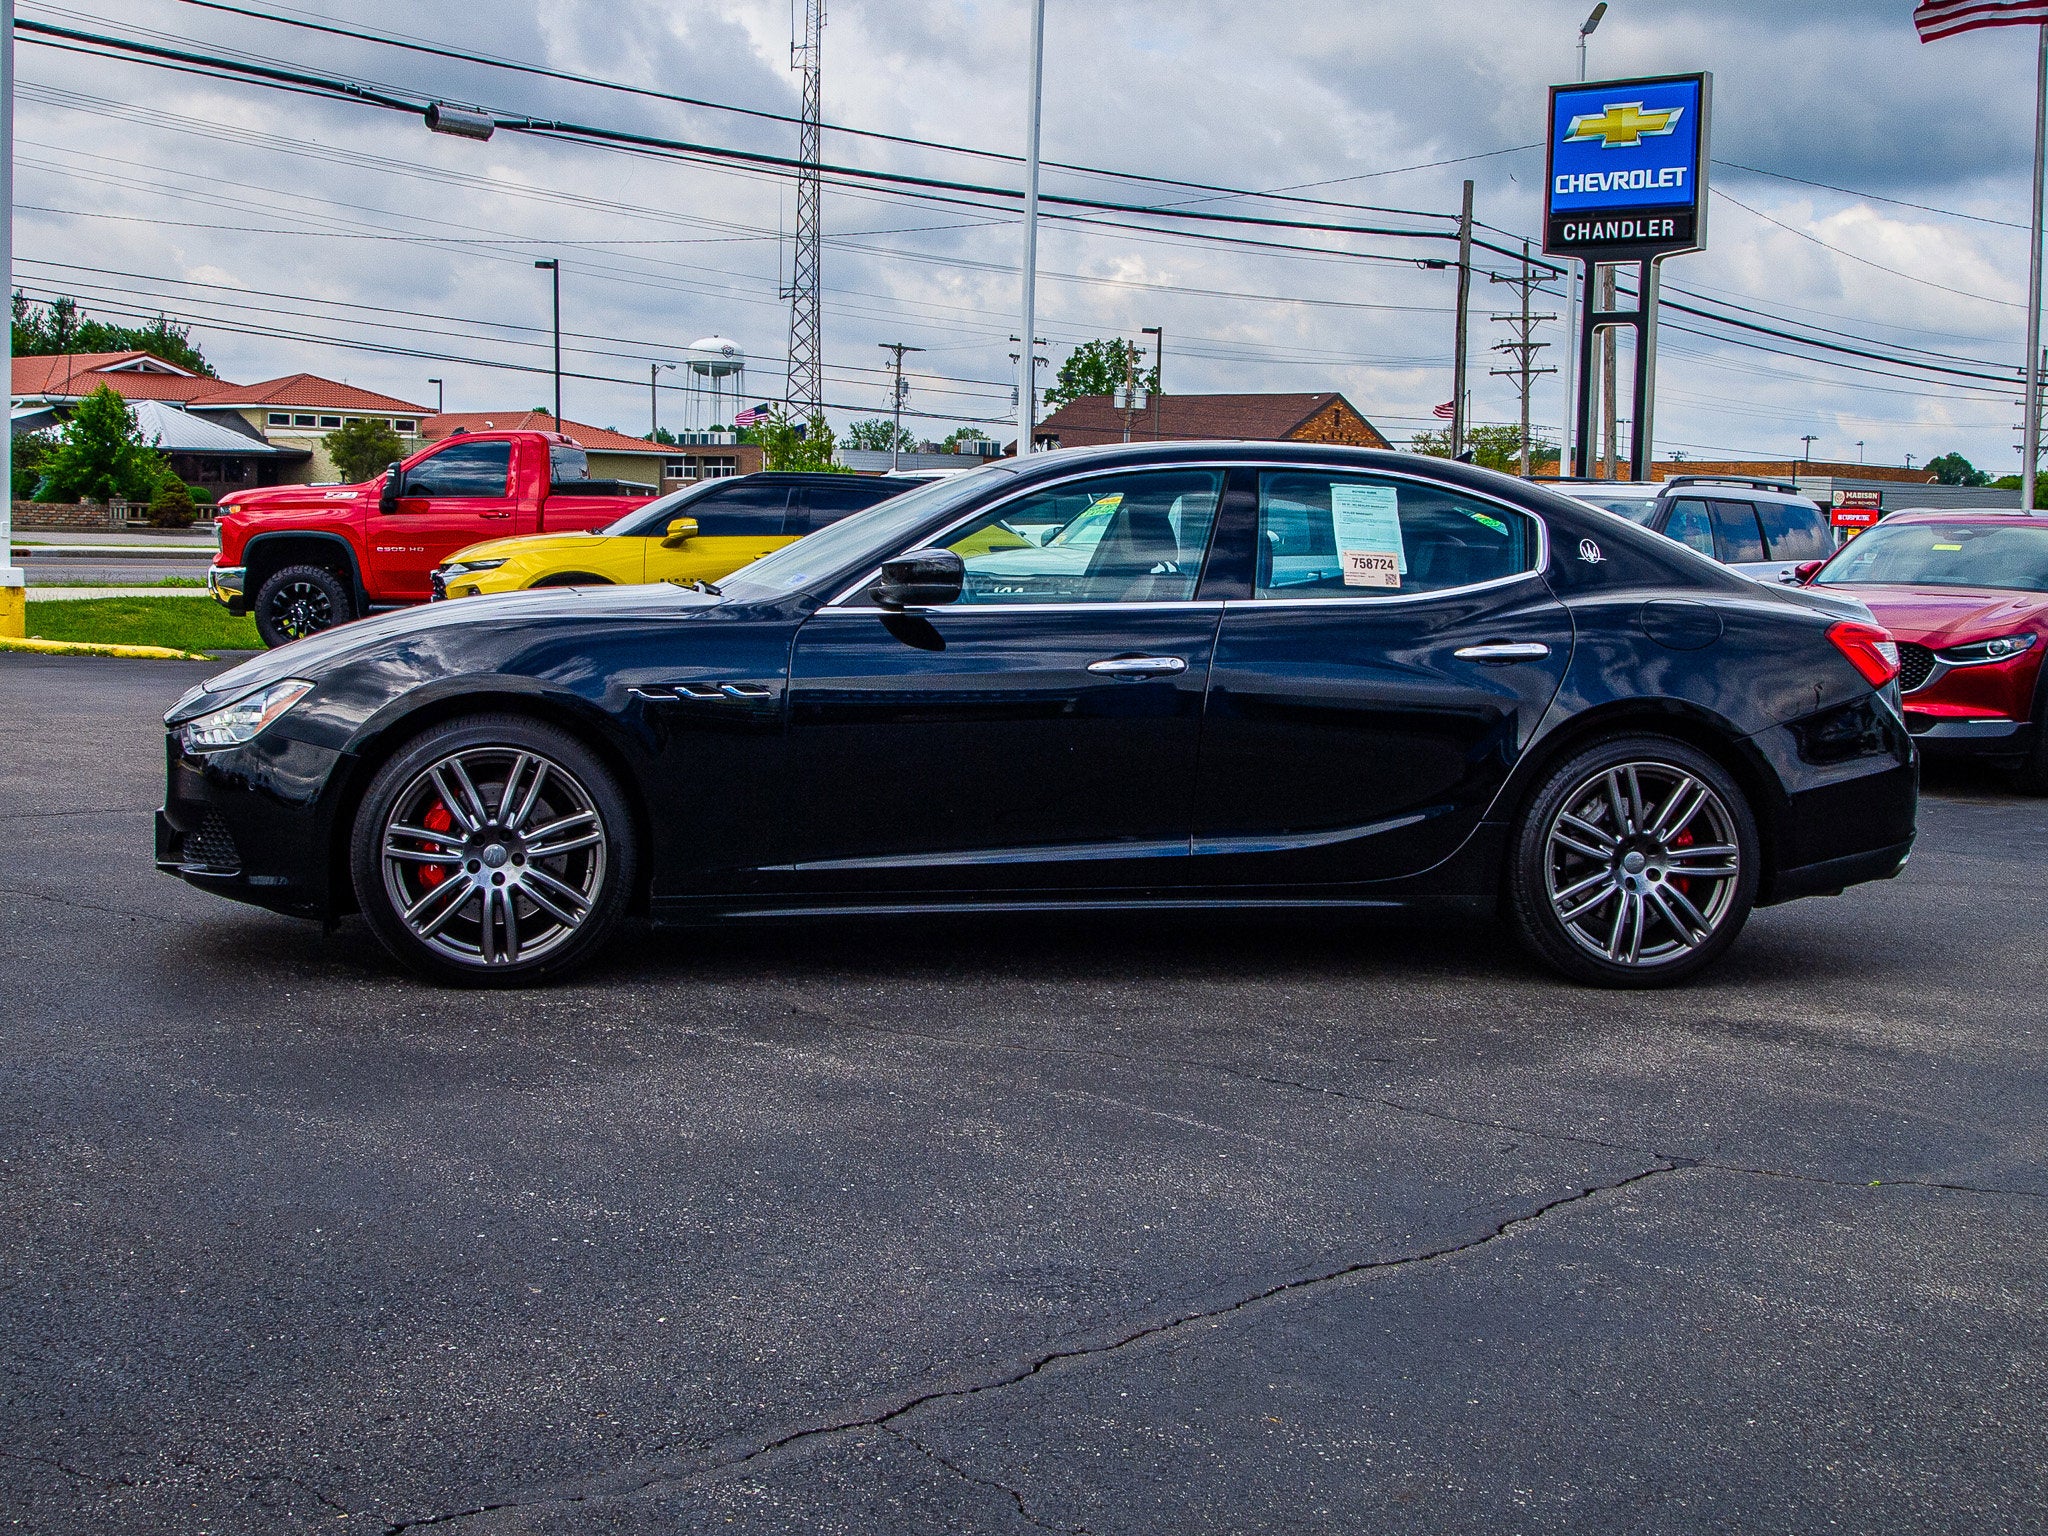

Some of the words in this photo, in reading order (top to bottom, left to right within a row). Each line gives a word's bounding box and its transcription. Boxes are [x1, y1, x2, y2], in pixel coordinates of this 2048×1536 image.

[1555, 167, 1688, 194] CHEVROLET
[1563, 219, 1675, 241] CHANDLER
[1351, 557, 1395, 571] 758724
